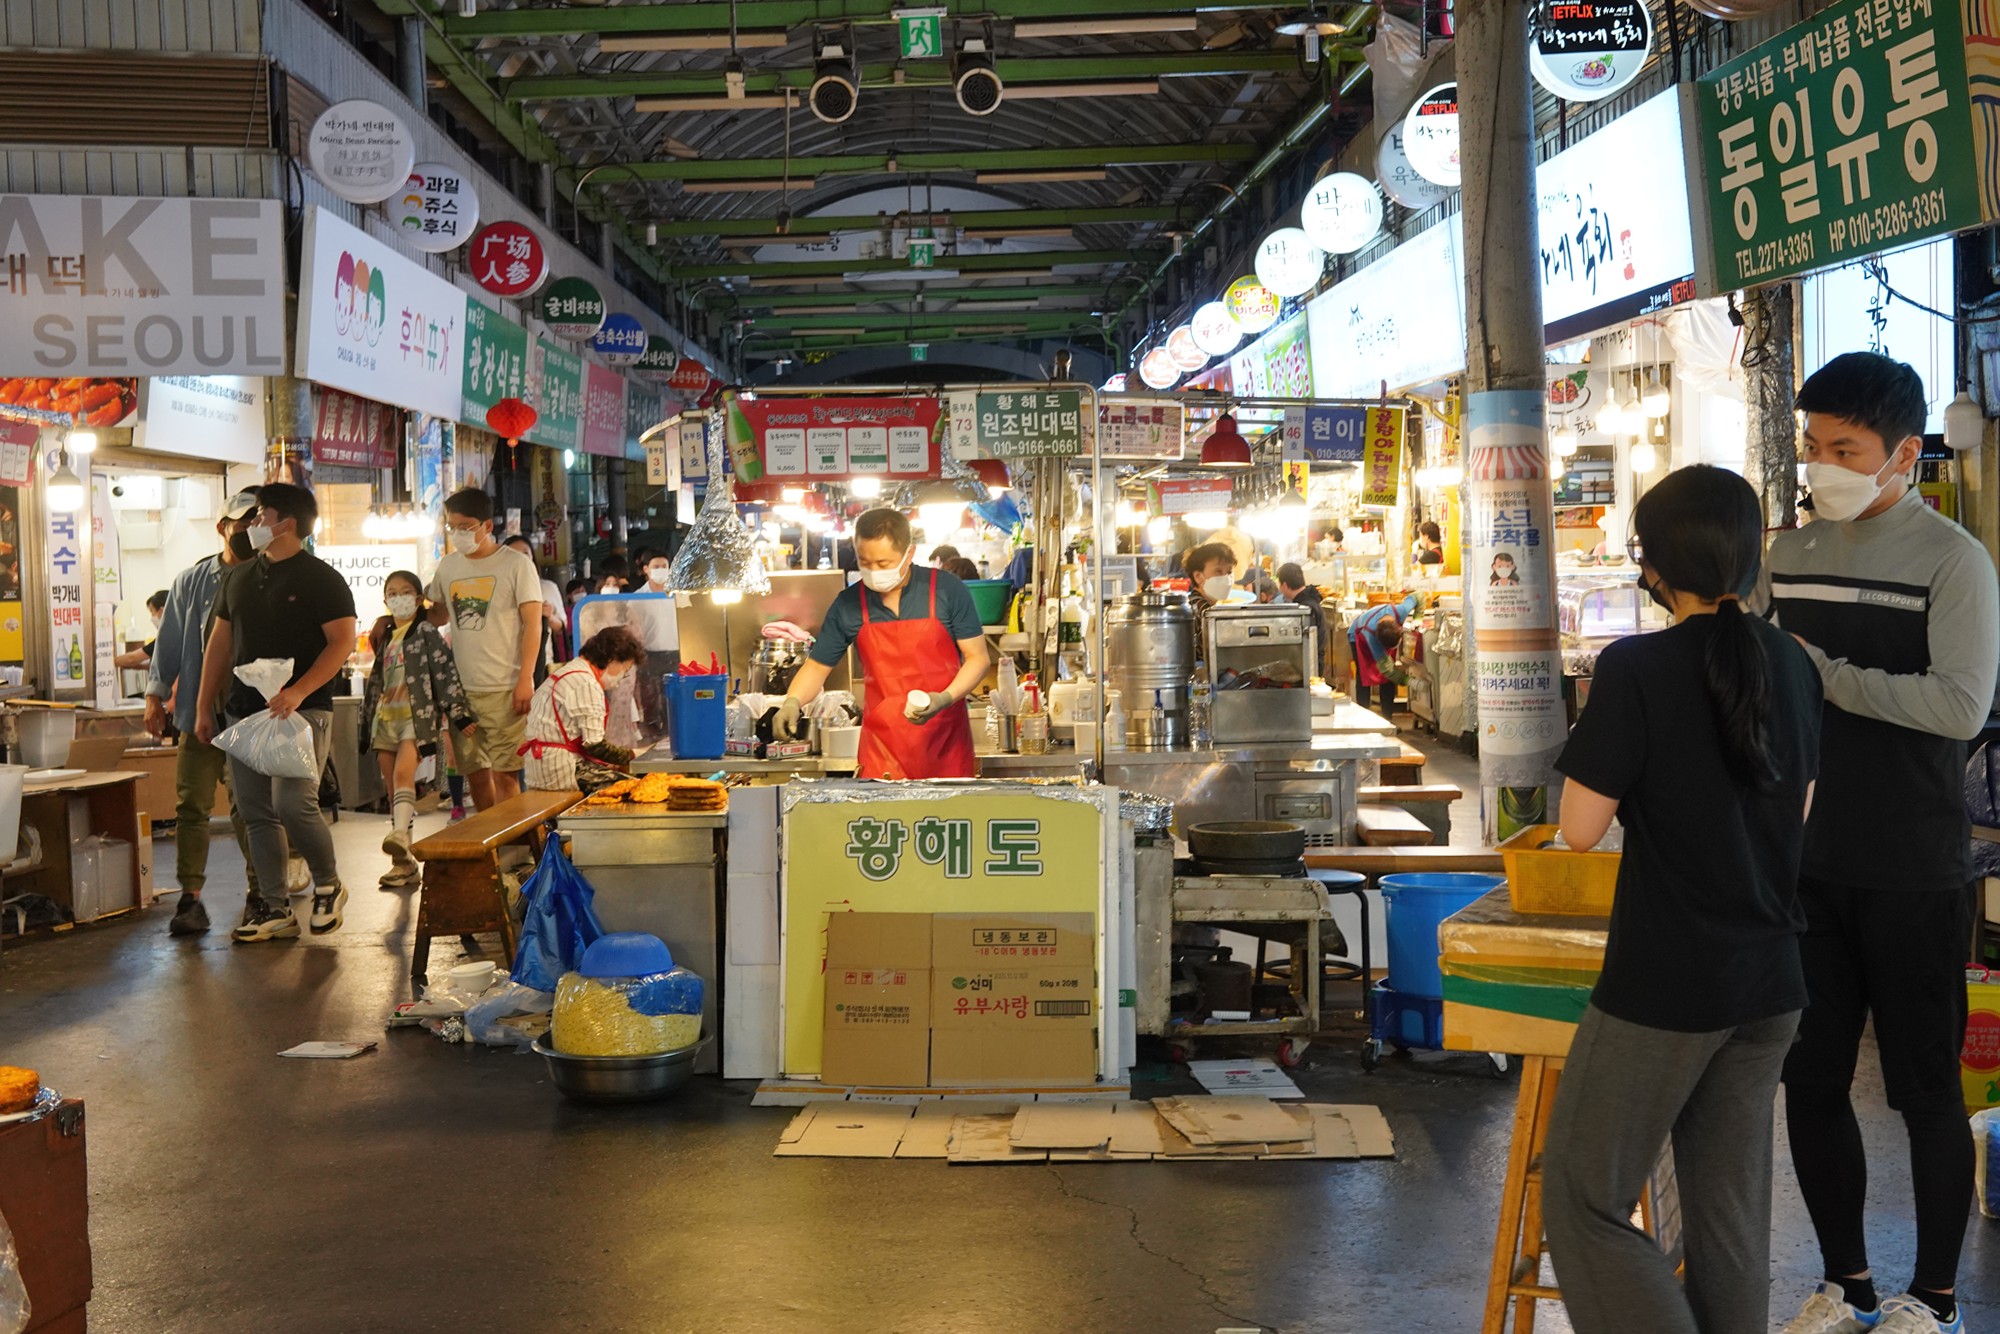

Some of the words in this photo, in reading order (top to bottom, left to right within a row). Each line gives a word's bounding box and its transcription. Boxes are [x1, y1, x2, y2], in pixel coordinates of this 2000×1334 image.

[1611, 19, 1642, 48] 육회
[325, 119, 358, 131] 박가네
[362, 120, 394, 132] 빈대떡
[320, 136, 343, 145] Mung
[345, 137, 365, 145] Bean
[1718, 29, 1948, 241] 동일유통
[425, 176, 460, 194] 과일
[424, 197, 458, 215] 쥬스
[423, 218, 457, 236] 후식
[1828, 217, 1846, 254] HP
[1849, 187, 1947, 248] 010-5286-3361
[481, 233, 532, 260] 广场
[480, 260, 530, 286] 人参
[33, 313, 282, 368] SEOUL
[469, 335, 520, 398] 광장식품
[951, 402, 975, 414] 동부A
[996, 394, 1061, 410] 황해도
[955, 418, 972, 431] 73
[981, 411, 1078, 437] 원조빈대떡
[958, 435, 971, 446] 호
[1286, 427, 1301, 439] 46
[691, 446, 696, 454] 1
[993, 439, 1078, 455] 010-9166-0661
[653, 458, 660, 466] 3
[51, 512, 76, 575] 국수
[346, 556, 391, 569] JUICE
[52, 585, 81, 603] 박가네
[1861, 592, 1870, 600] LE
[1871, 592, 1889, 602] COQ
[1890, 594, 1923, 607] SPORTIF
[53, 607, 81, 626] 빈대떡
[1507, 660, 1550, 675] 방역수칙
[1536, 676, 1550, 690] 꼭!
[845, 816, 1044, 882] 황해도
[982, 931, 1048, 943] 냉동보관
[1022, 946, 1057, 956] 냉동보관
[970, 975, 992, 991] 신미
[953, 995, 1030, 1019] 유부사랑
